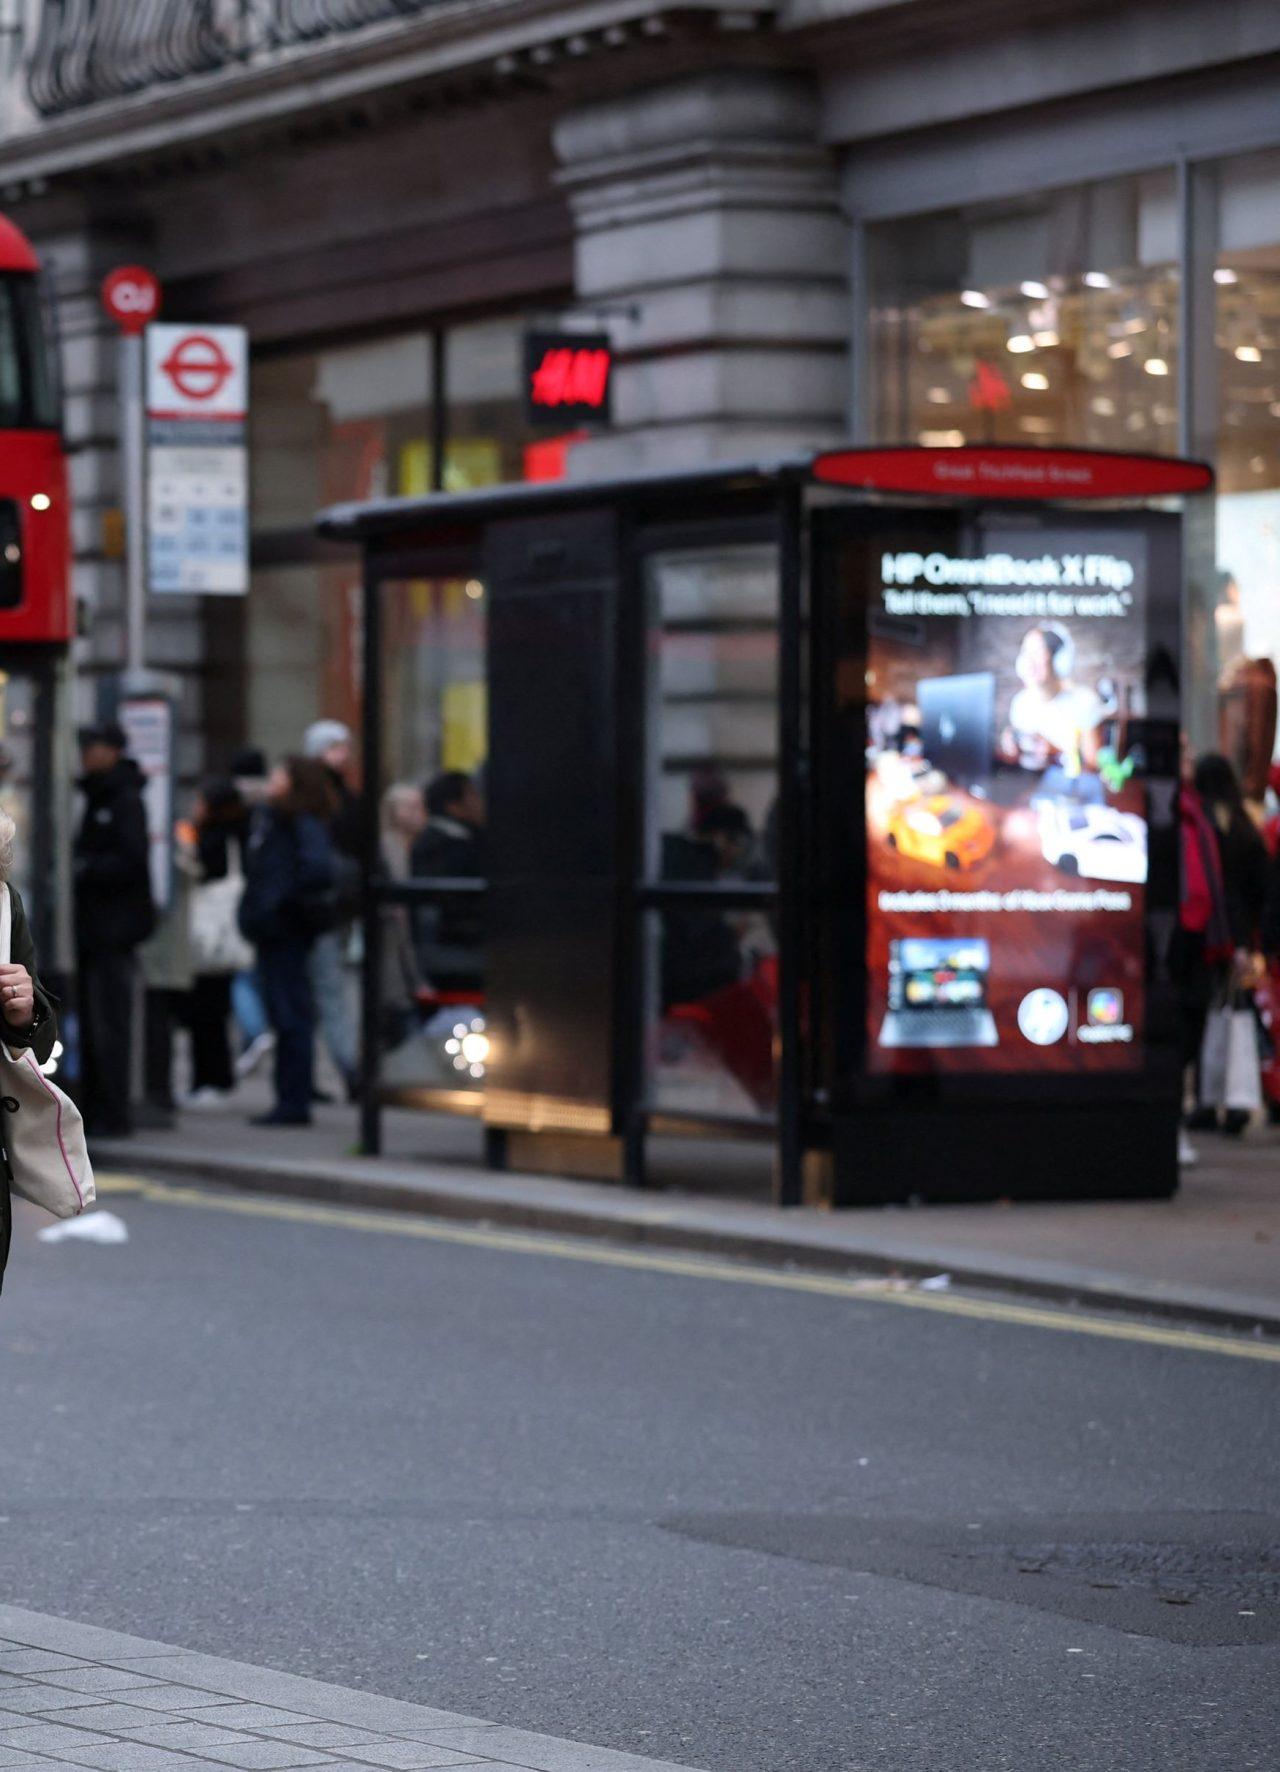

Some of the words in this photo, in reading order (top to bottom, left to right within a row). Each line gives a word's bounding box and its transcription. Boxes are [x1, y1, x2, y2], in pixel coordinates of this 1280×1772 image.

[881, 552, 923, 584] HP
[923, 552, 1061, 585] OmniBook
[1061, 553, 1083, 586] X
[1083, 554, 1134, 591] Flip
